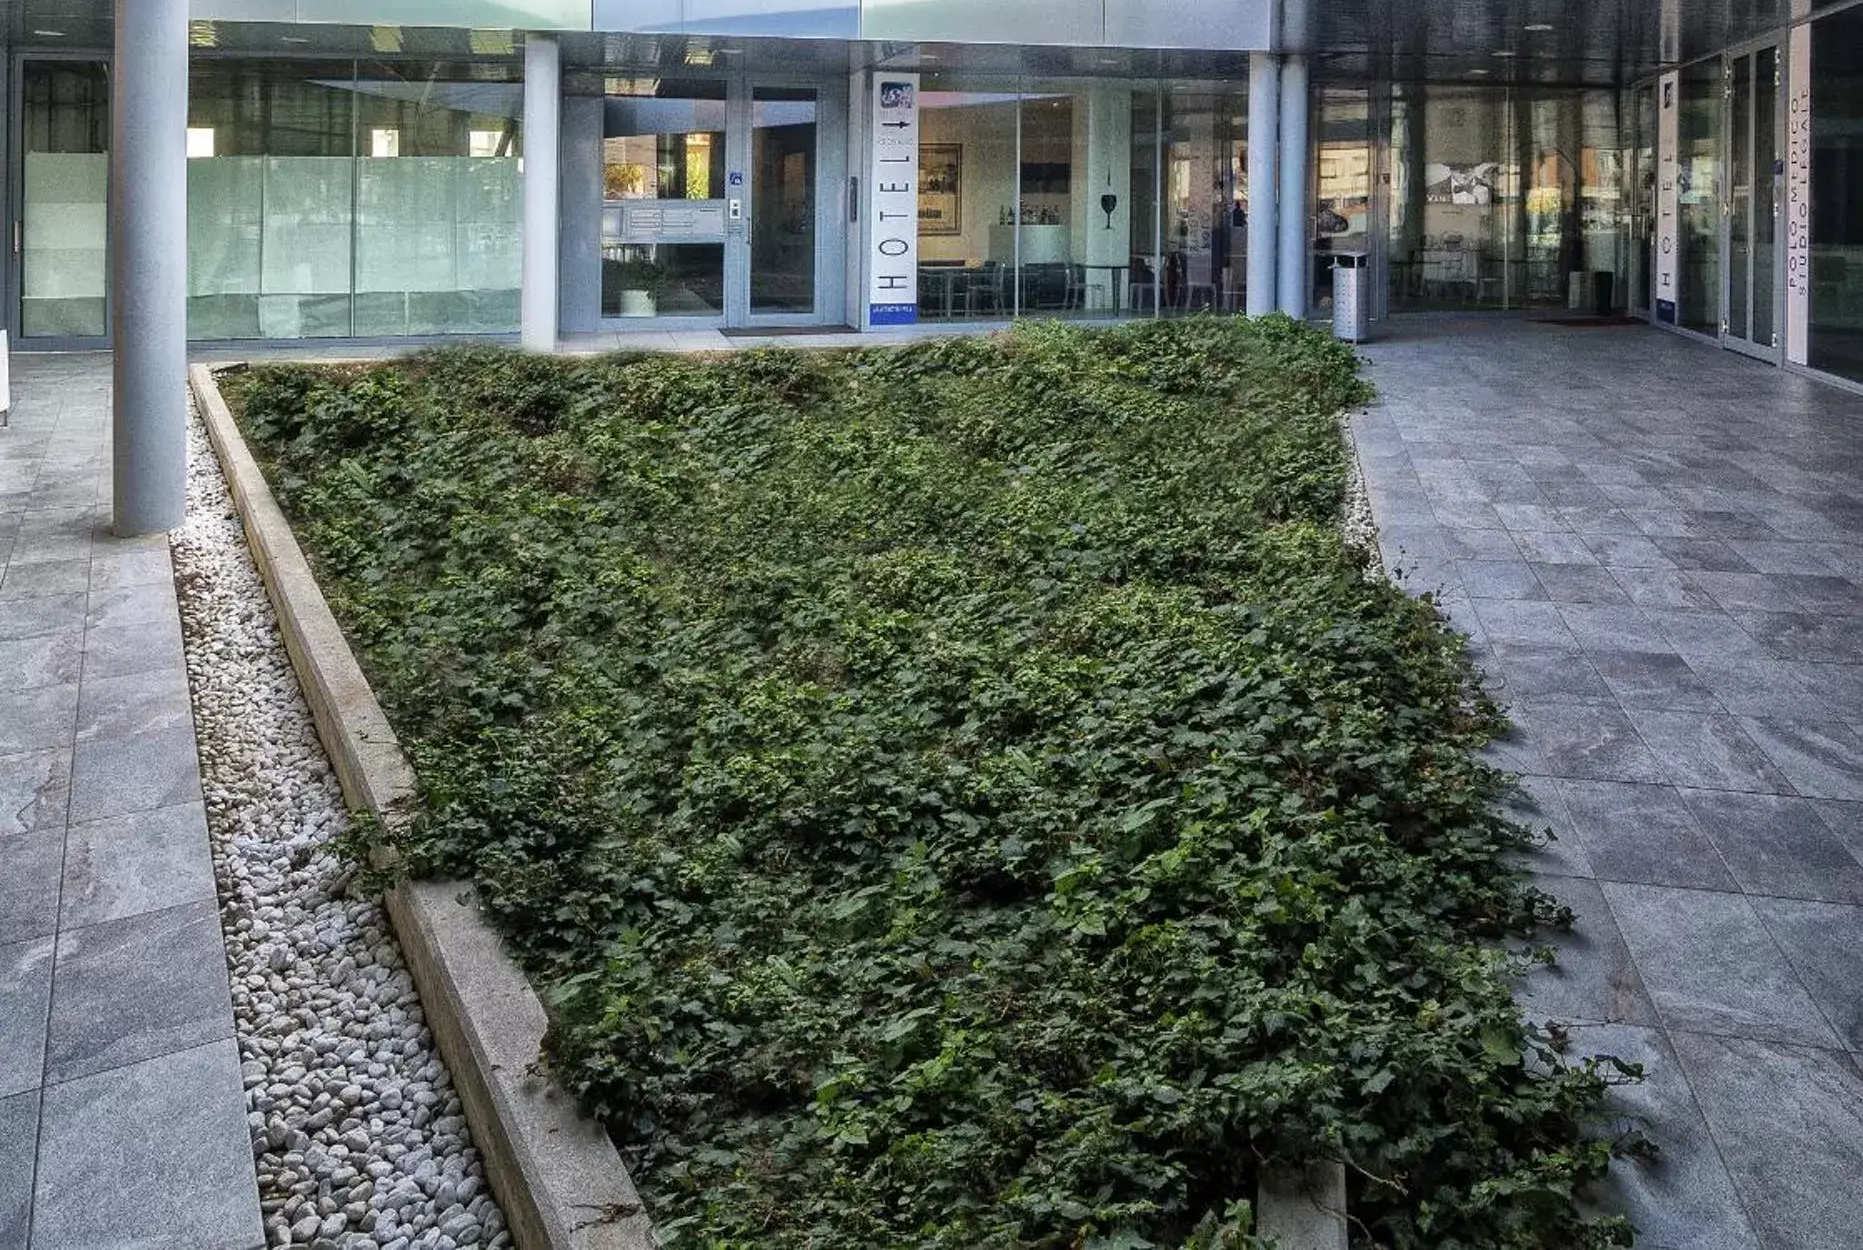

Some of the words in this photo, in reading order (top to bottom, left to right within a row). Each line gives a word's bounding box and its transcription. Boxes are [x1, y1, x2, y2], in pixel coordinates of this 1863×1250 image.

[1790, 98, 1799, 203] MEDICO
[1800, 86, 1809, 185] LEGALE
[878, 156, 910, 289] HOTEL
[1661, 156, 1672, 286] HOTEL
[1788, 221, 1798, 289] POLO
[1799, 203, 1808, 296] STUDIO
